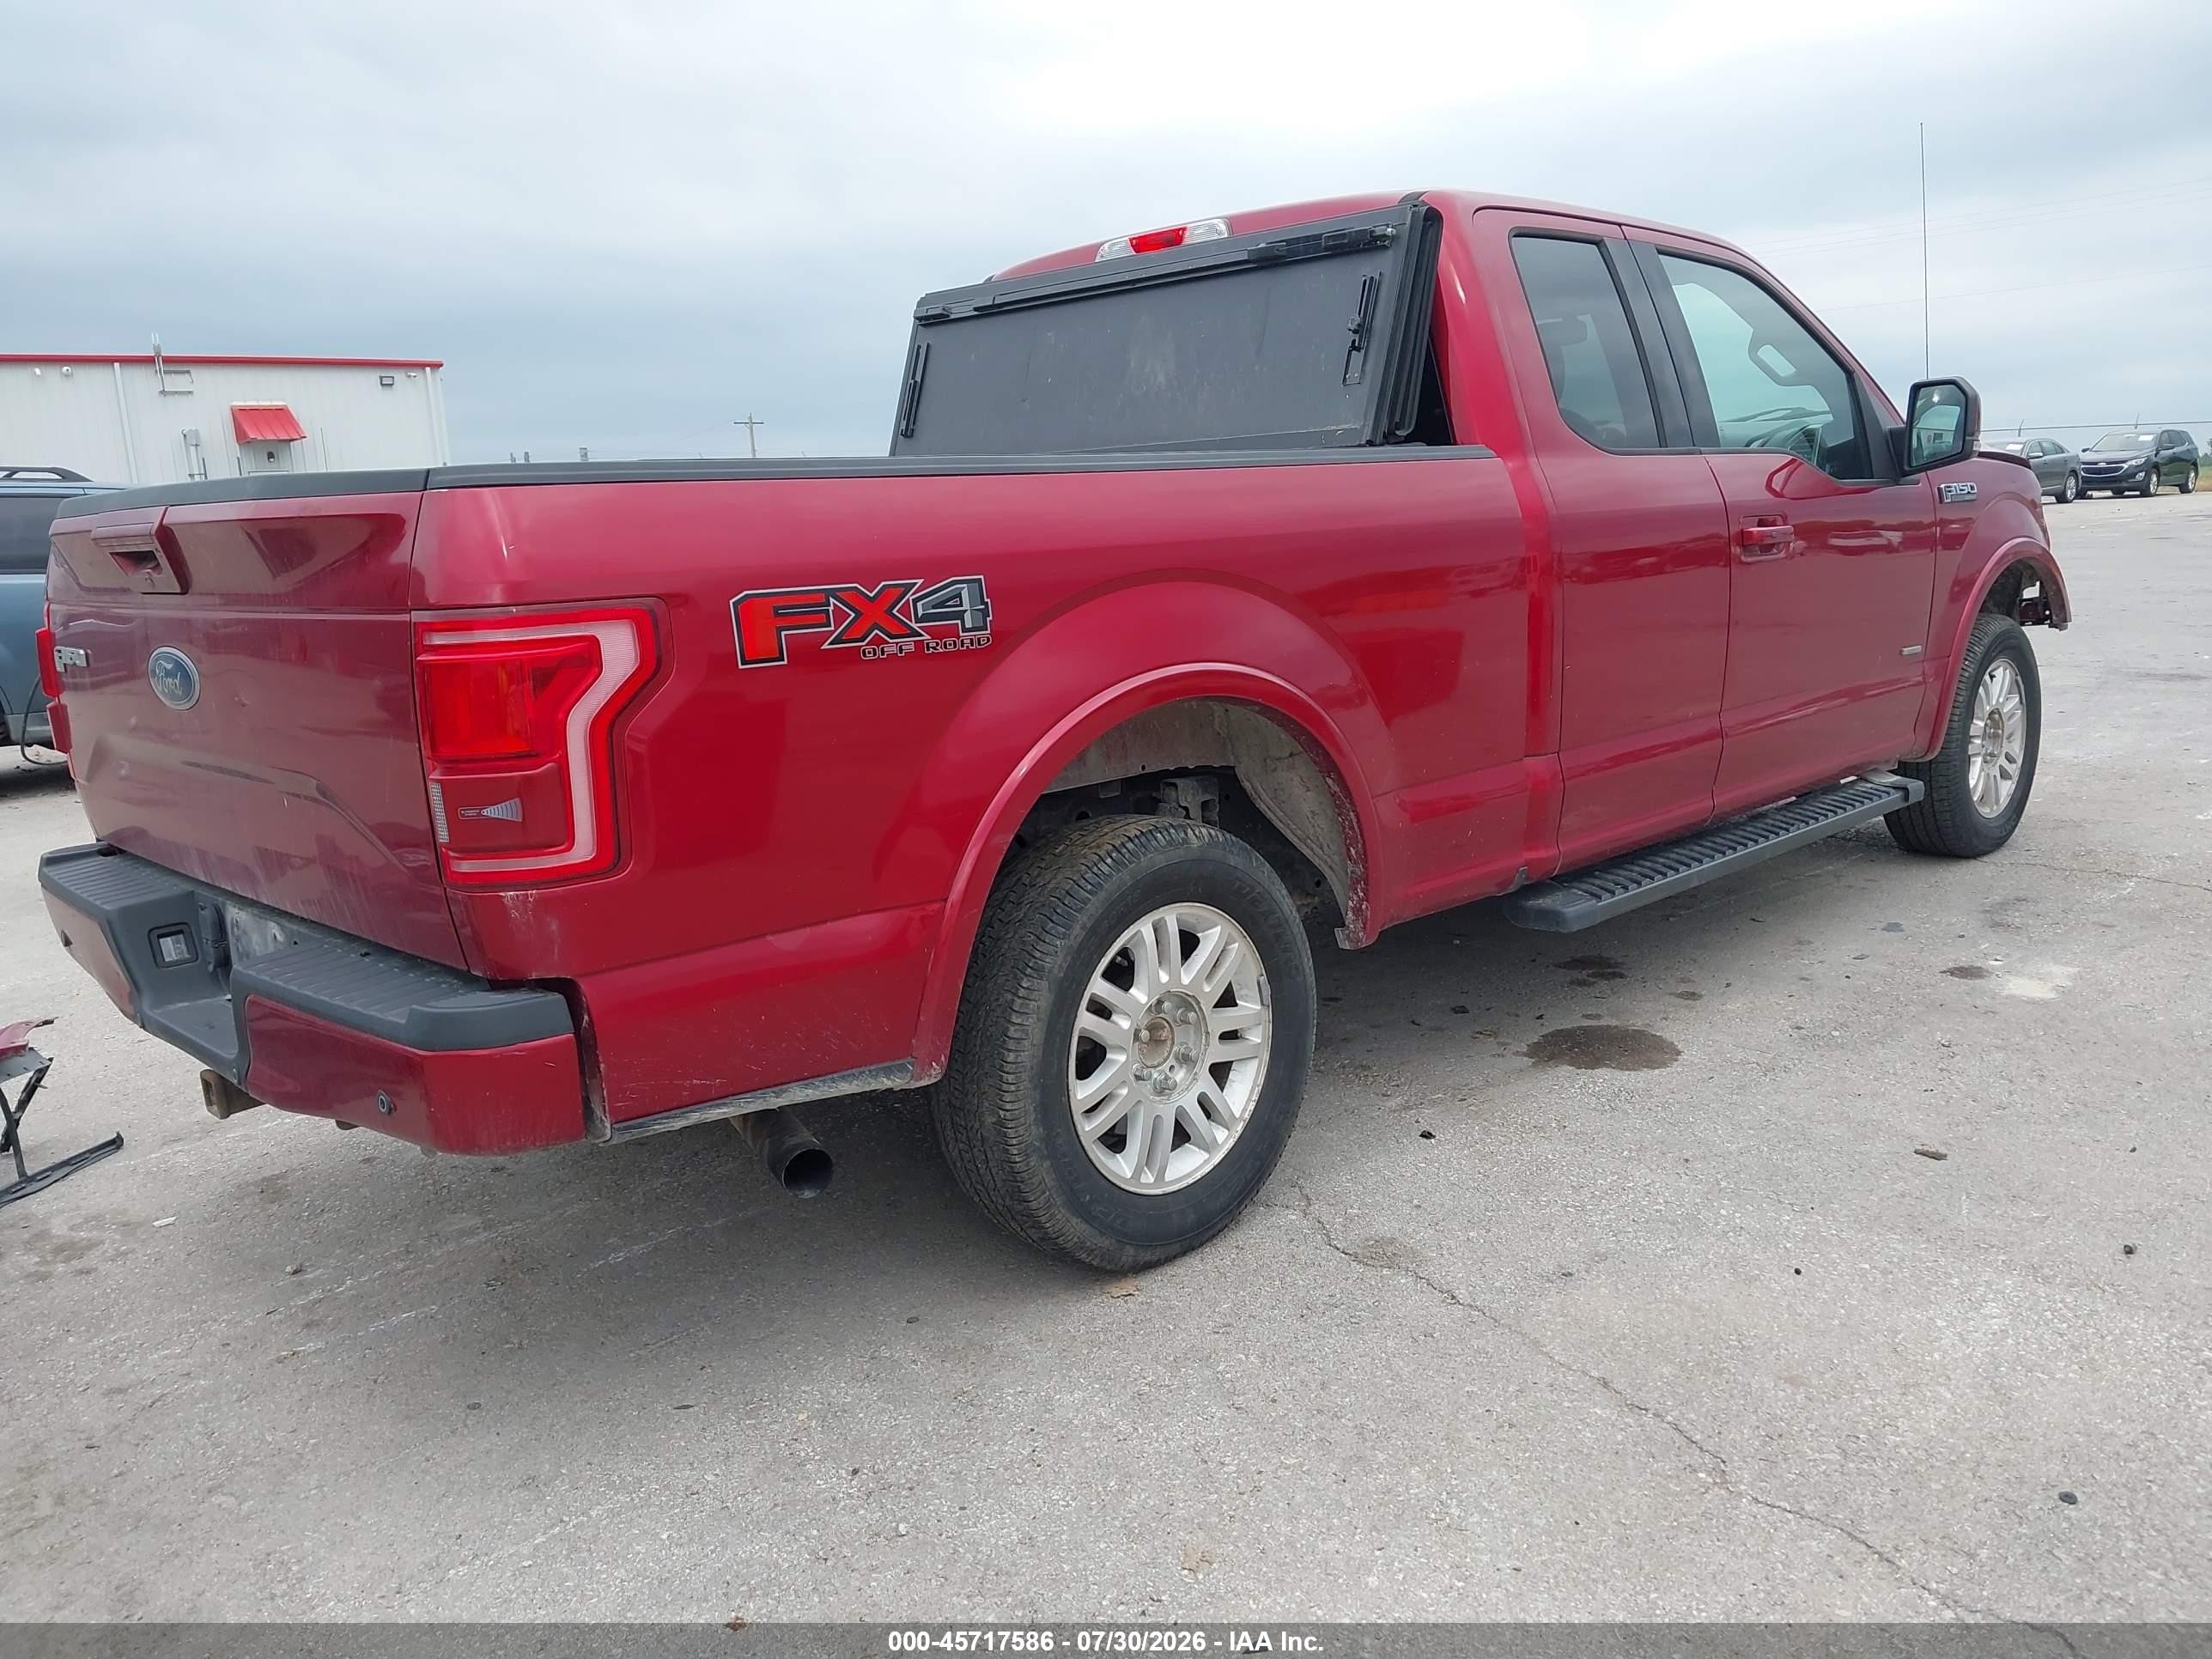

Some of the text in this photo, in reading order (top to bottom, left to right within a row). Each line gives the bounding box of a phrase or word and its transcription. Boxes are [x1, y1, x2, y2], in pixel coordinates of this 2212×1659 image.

[730, 574, 993, 669] FX4
[860, 634, 993, 660] OFF ROAD
